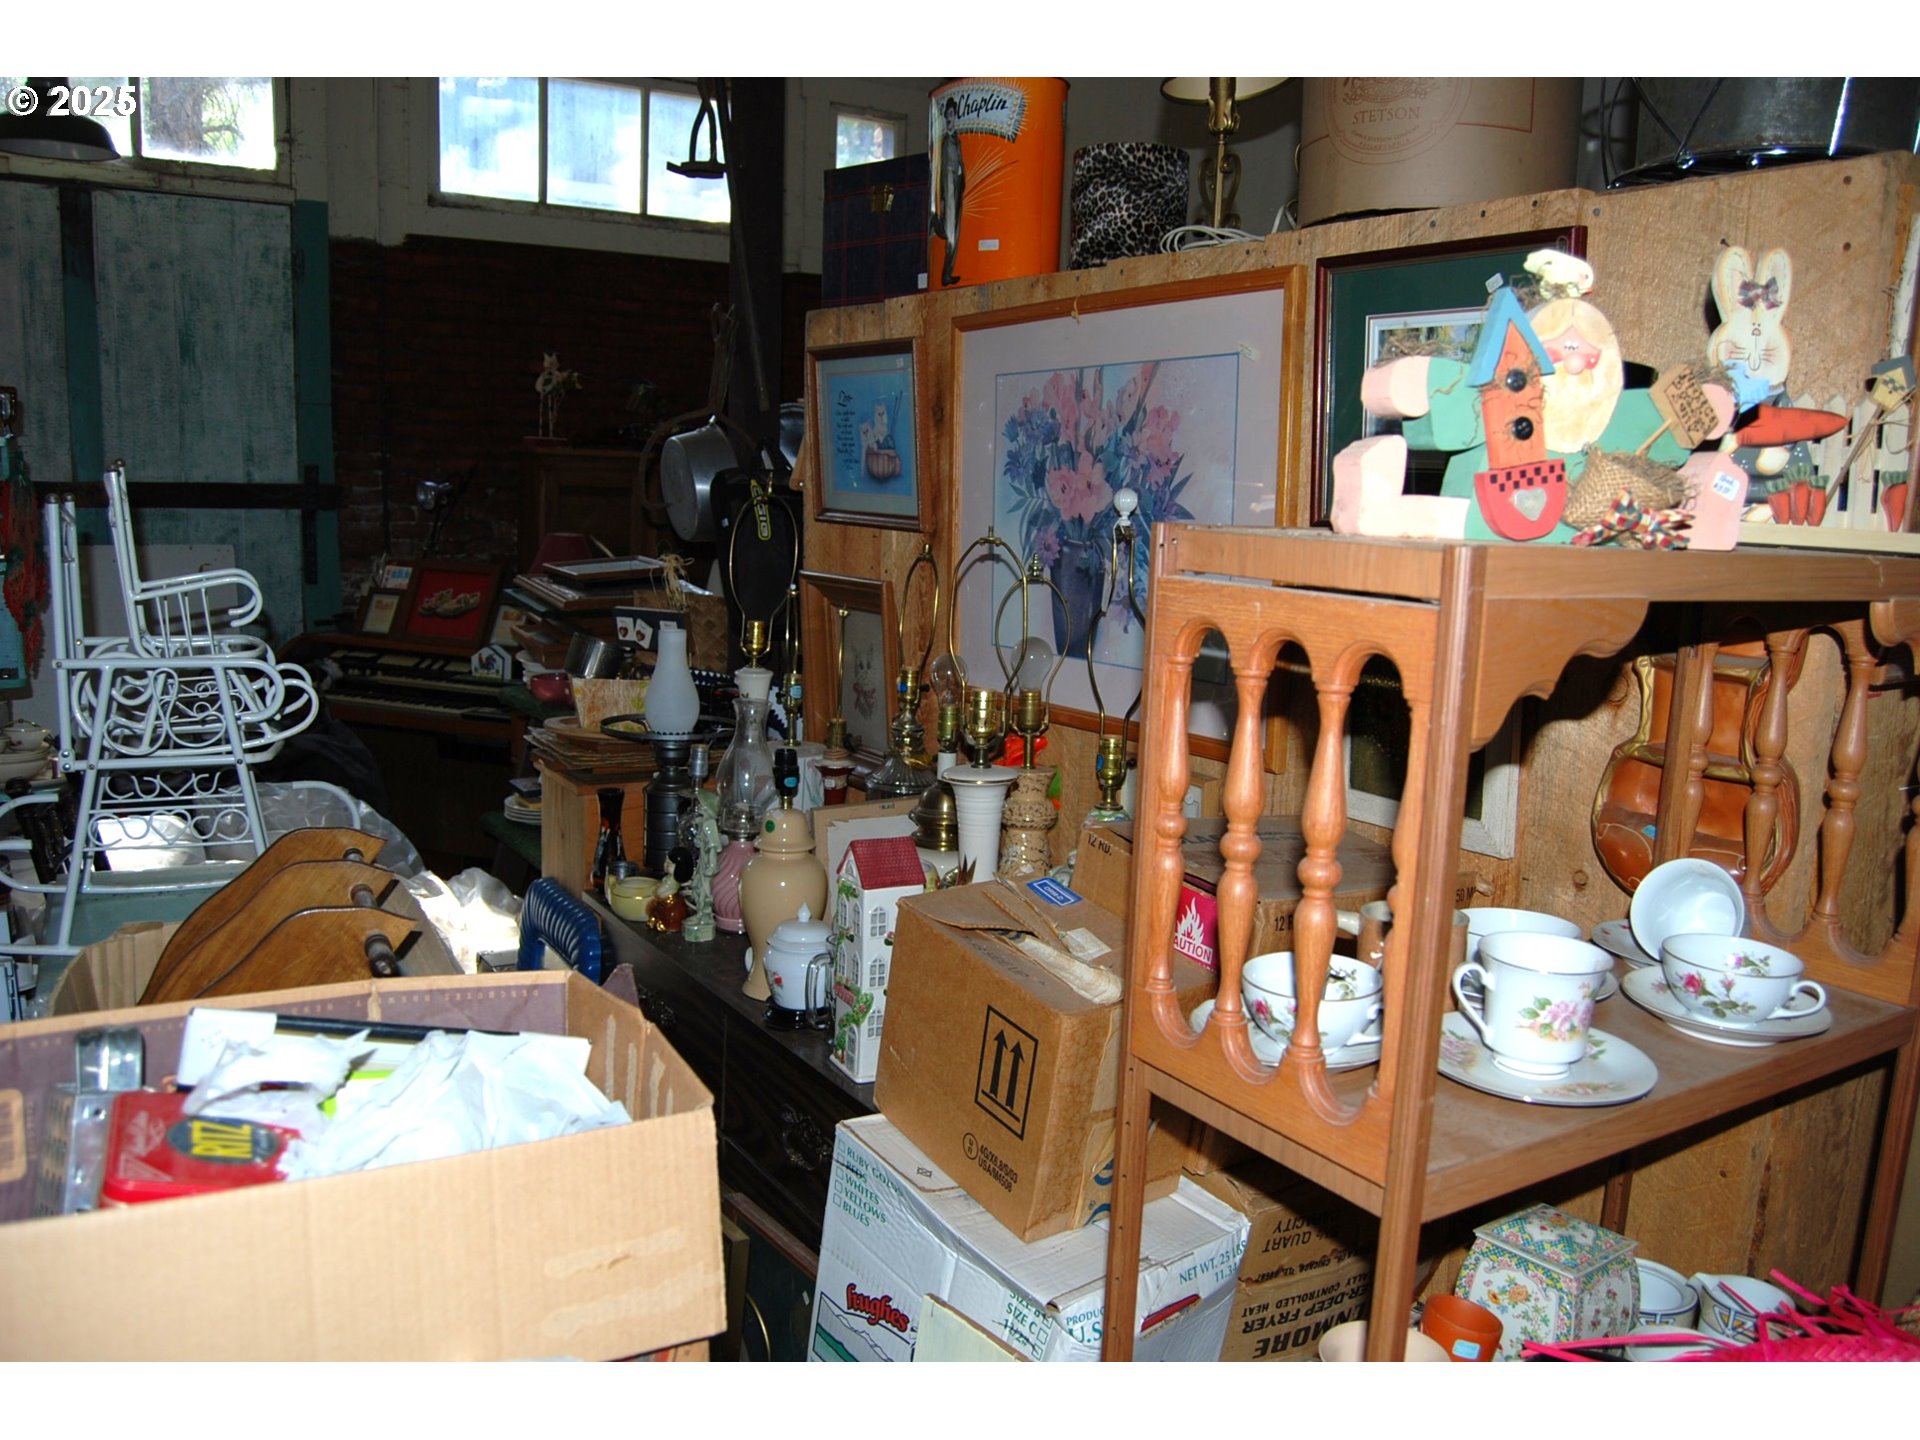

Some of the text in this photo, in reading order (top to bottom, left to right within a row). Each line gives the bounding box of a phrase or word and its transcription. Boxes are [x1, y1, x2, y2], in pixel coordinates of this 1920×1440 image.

[957, 93, 1008, 119] Chaplin
[1352, 106, 1421, 125] STETSON
[1274, 916, 1285, 932] 12
[1175, 936, 1212, 962] AUTION
[190, 1119, 253, 1159] RITZ
[847, 1147, 870, 1170] RUBY
[845, 1173, 880, 1205] WHITES
[843, 1201, 870, 1227] BLUES
[844, 1187, 886, 1224] YELLOWS
[1262, 1230, 1312, 1253] QUART
[1179, 1265, 1198, 1285] NET
[1200, 1257, 1218, 1275] WT.
[1220, 1251, 1230, 1265] 25
[1215, 1262, 1237, 1282] 11.34
[846, 1282, 910, 1333] hughes
[1275, 1283, 1340, 1310] CONTROLLED
[1006, 1302, 1038, 1335] SIZE C
[1066, 1306, 1105, 1326] PRODUC
[1240, 1302, 1269, 1318] HEAT
[1242, 1308, 1301, 1334] FRYER
[1068, 1321, 1103, 1343] U.S
